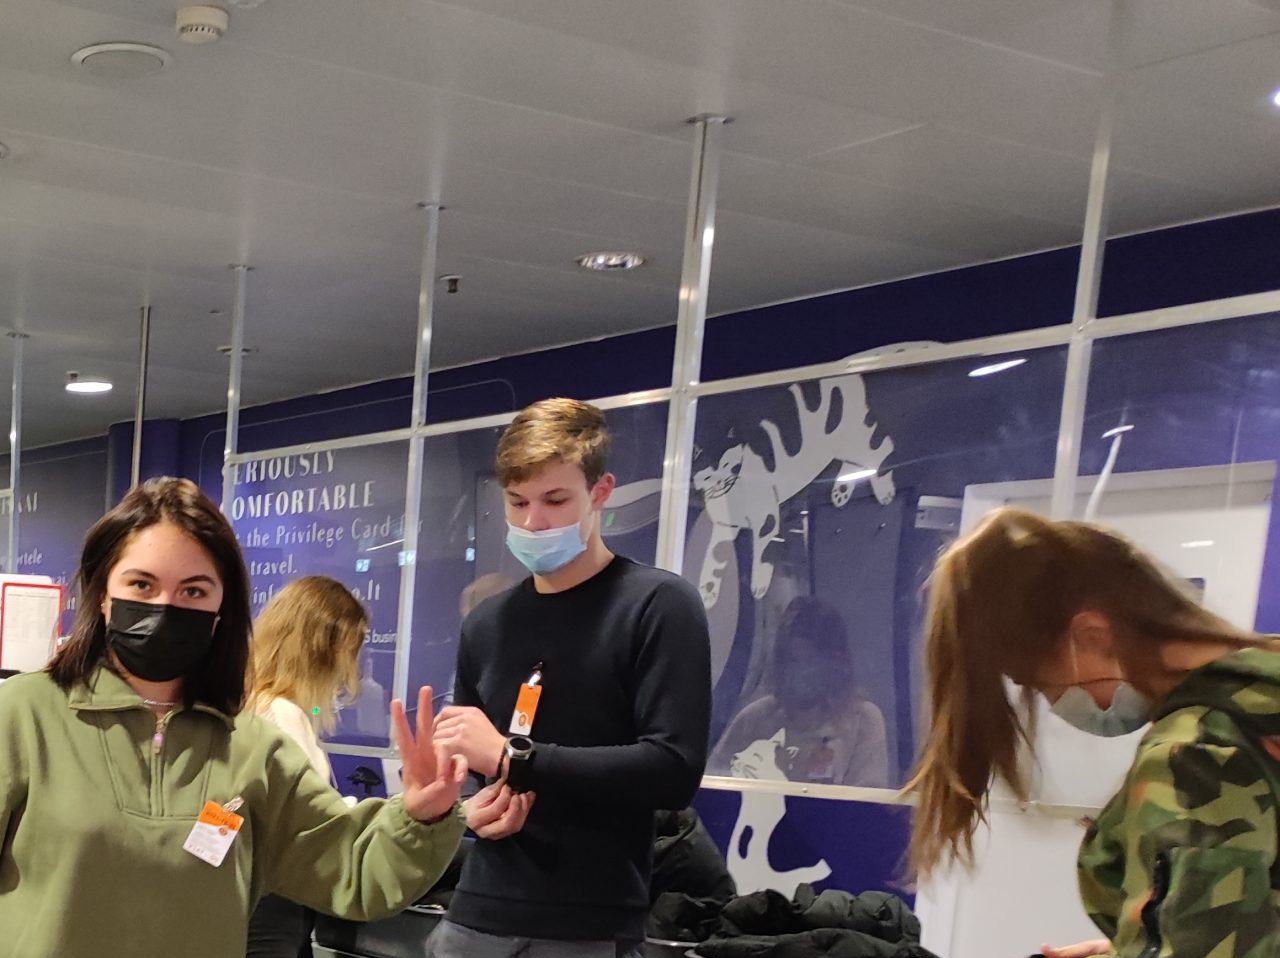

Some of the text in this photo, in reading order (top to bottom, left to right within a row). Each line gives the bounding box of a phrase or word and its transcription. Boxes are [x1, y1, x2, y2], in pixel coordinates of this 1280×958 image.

[223, 450, 336, 486] ERIOUSLY
[222, 480, 375, 521] OMFORTABLE
[246, 527, 269, 547] the
[275, 520, 344, 549] Privilege
[351, 514, 391, 540] Card
[250, 554, 297, 576] travel.
